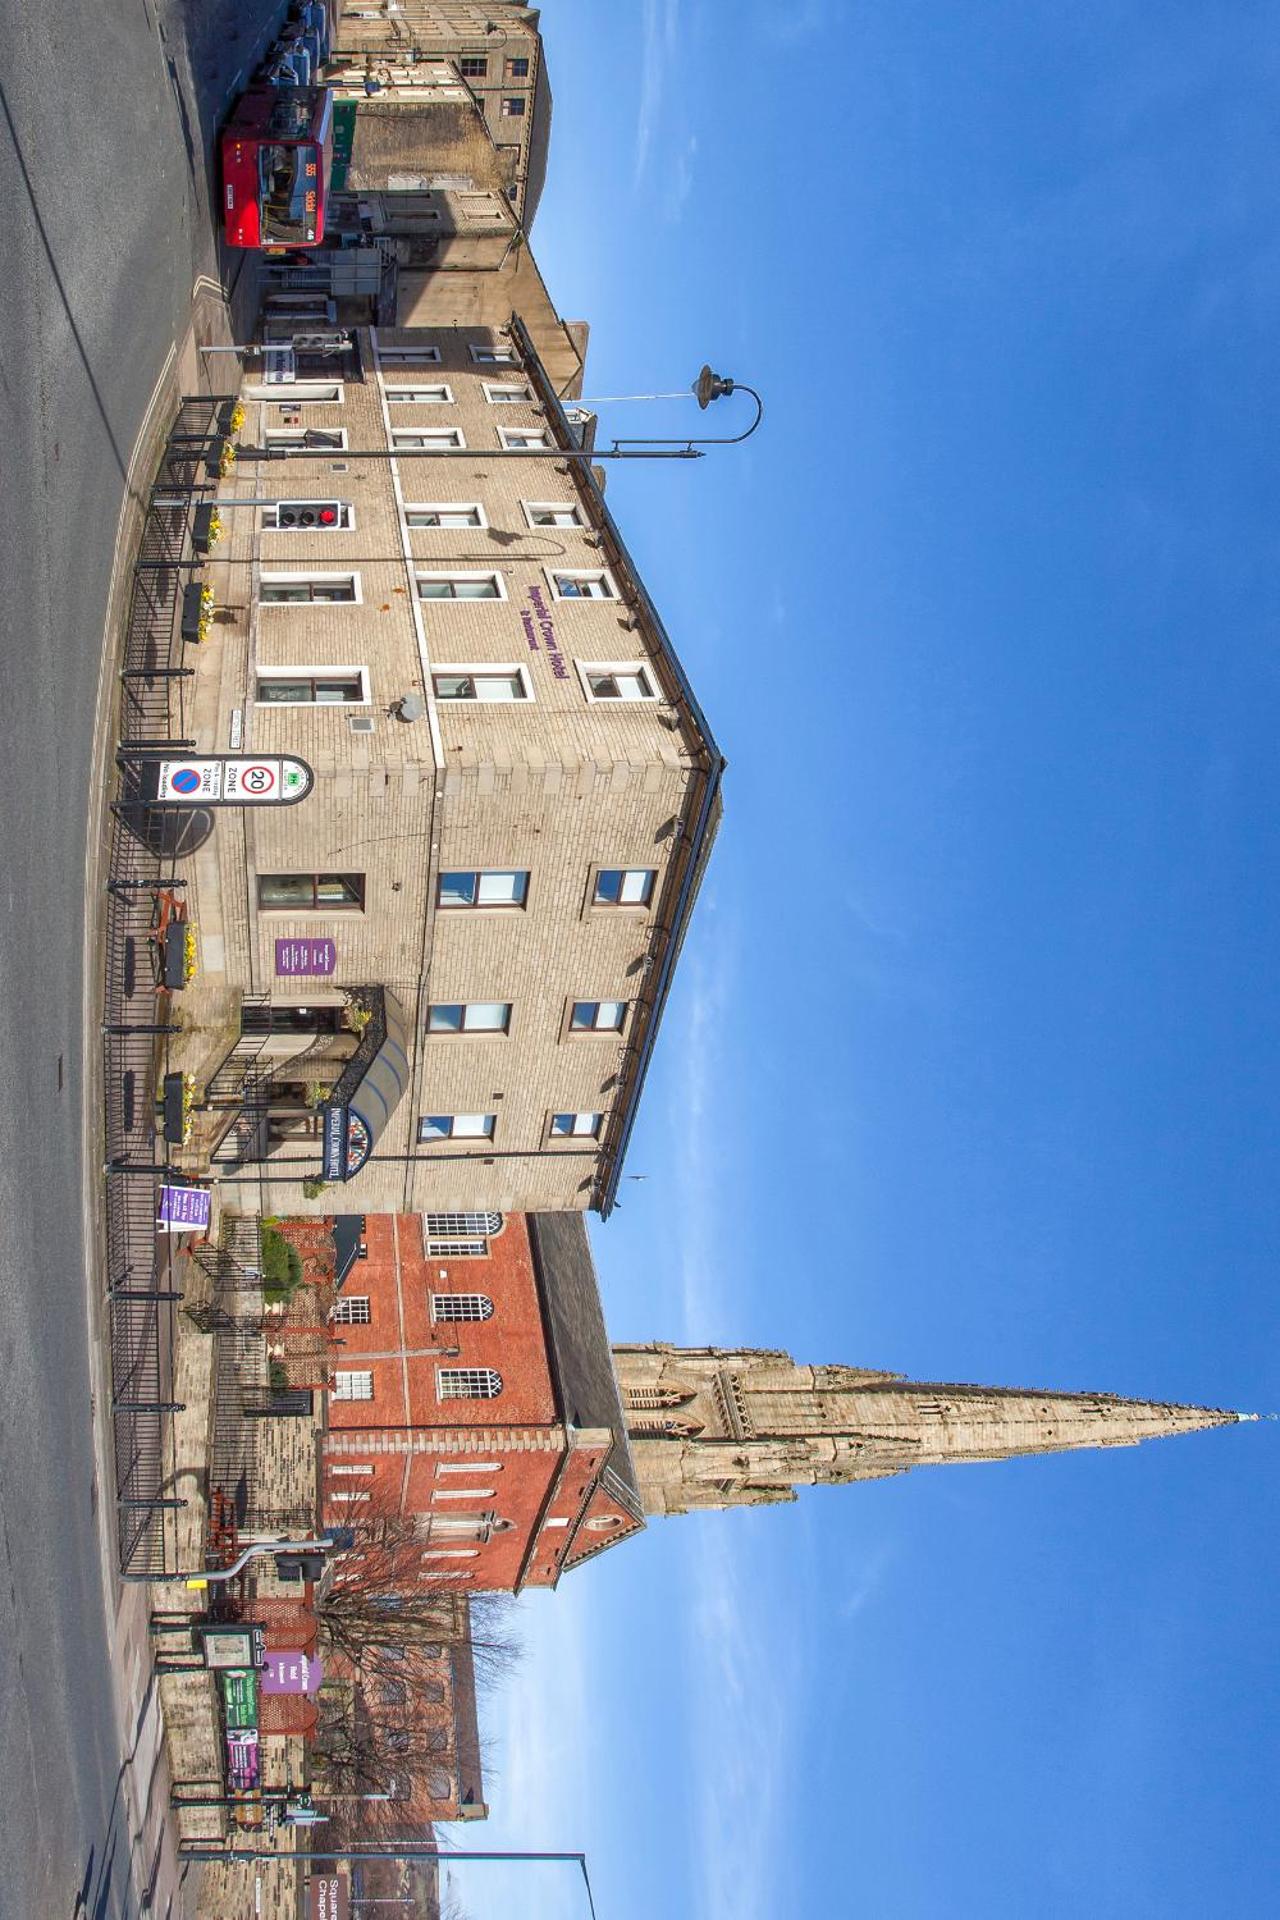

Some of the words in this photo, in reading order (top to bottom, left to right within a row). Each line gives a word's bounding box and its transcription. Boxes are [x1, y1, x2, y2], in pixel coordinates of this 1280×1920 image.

[305, 164, 316, 176] 555
[304, 190, 316, 212] Siddal
[528, 586, 552, 618] Imperial
[540, 621, 558, 650] Crown
[548, 653, 570, 679] Hotel
[163, 764, 170, 773] No
[202, 768, 211, 792] ZONE
[250, 771, 264, 789] 20
[227, 768, 237, 793] ZONE
[329, 1108, 341, 1136] IMPERIAL
[329, 1137, 341, 1158] CROWN
[328, 1160, 340, 1178] HOTEL
[298, 1655, 309, 1674] mperial
[328, 1880, 338, 1920] Square
